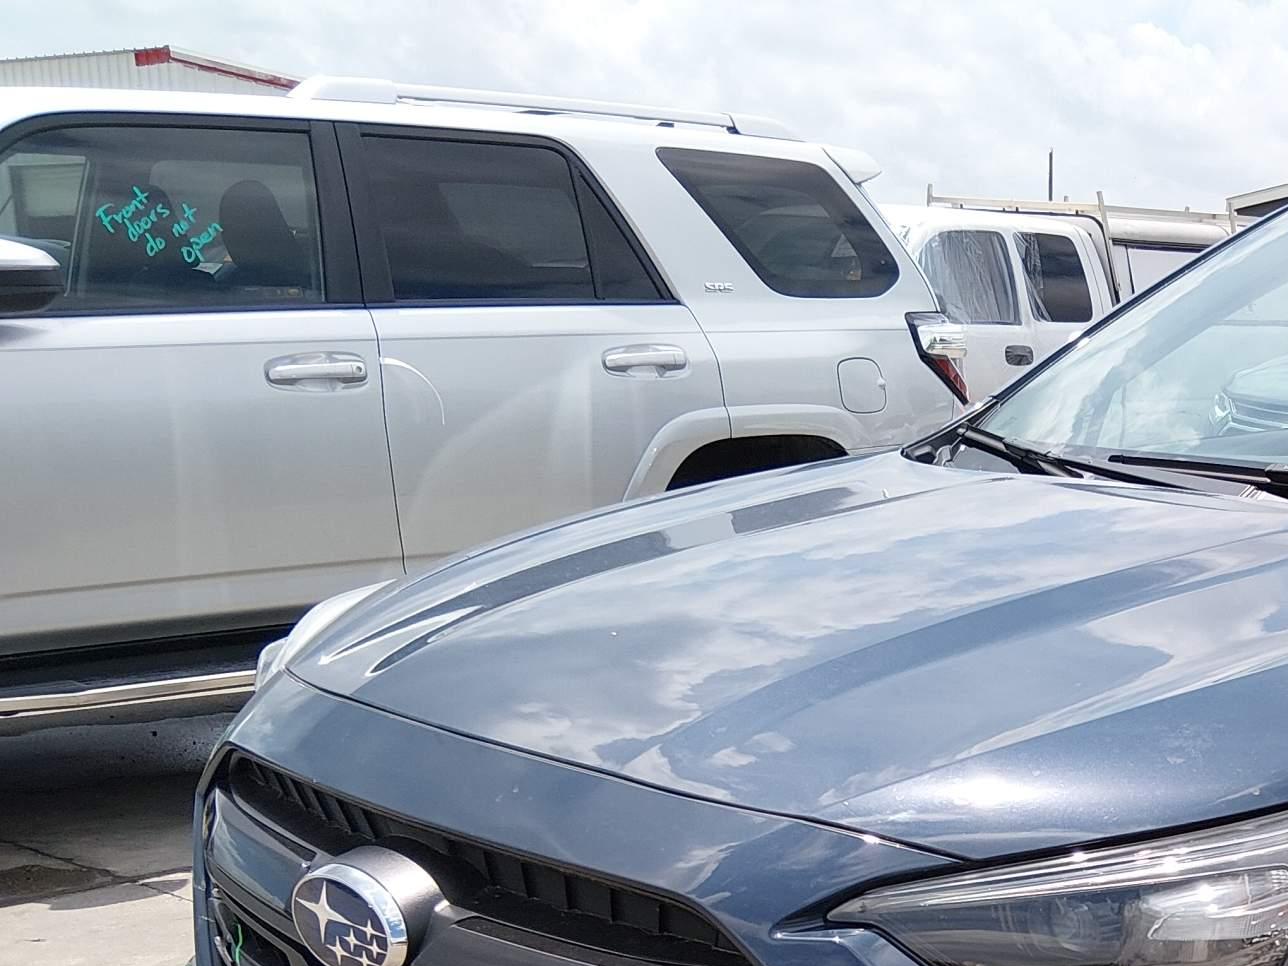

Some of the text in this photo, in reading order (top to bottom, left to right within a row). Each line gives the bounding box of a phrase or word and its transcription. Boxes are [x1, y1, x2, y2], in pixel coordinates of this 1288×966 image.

[96, 185, 149, 233] Front
[124, 203, 170, 242] doors
[145, 203, 197, 257] do not
[181, 223, 223, 263] open
